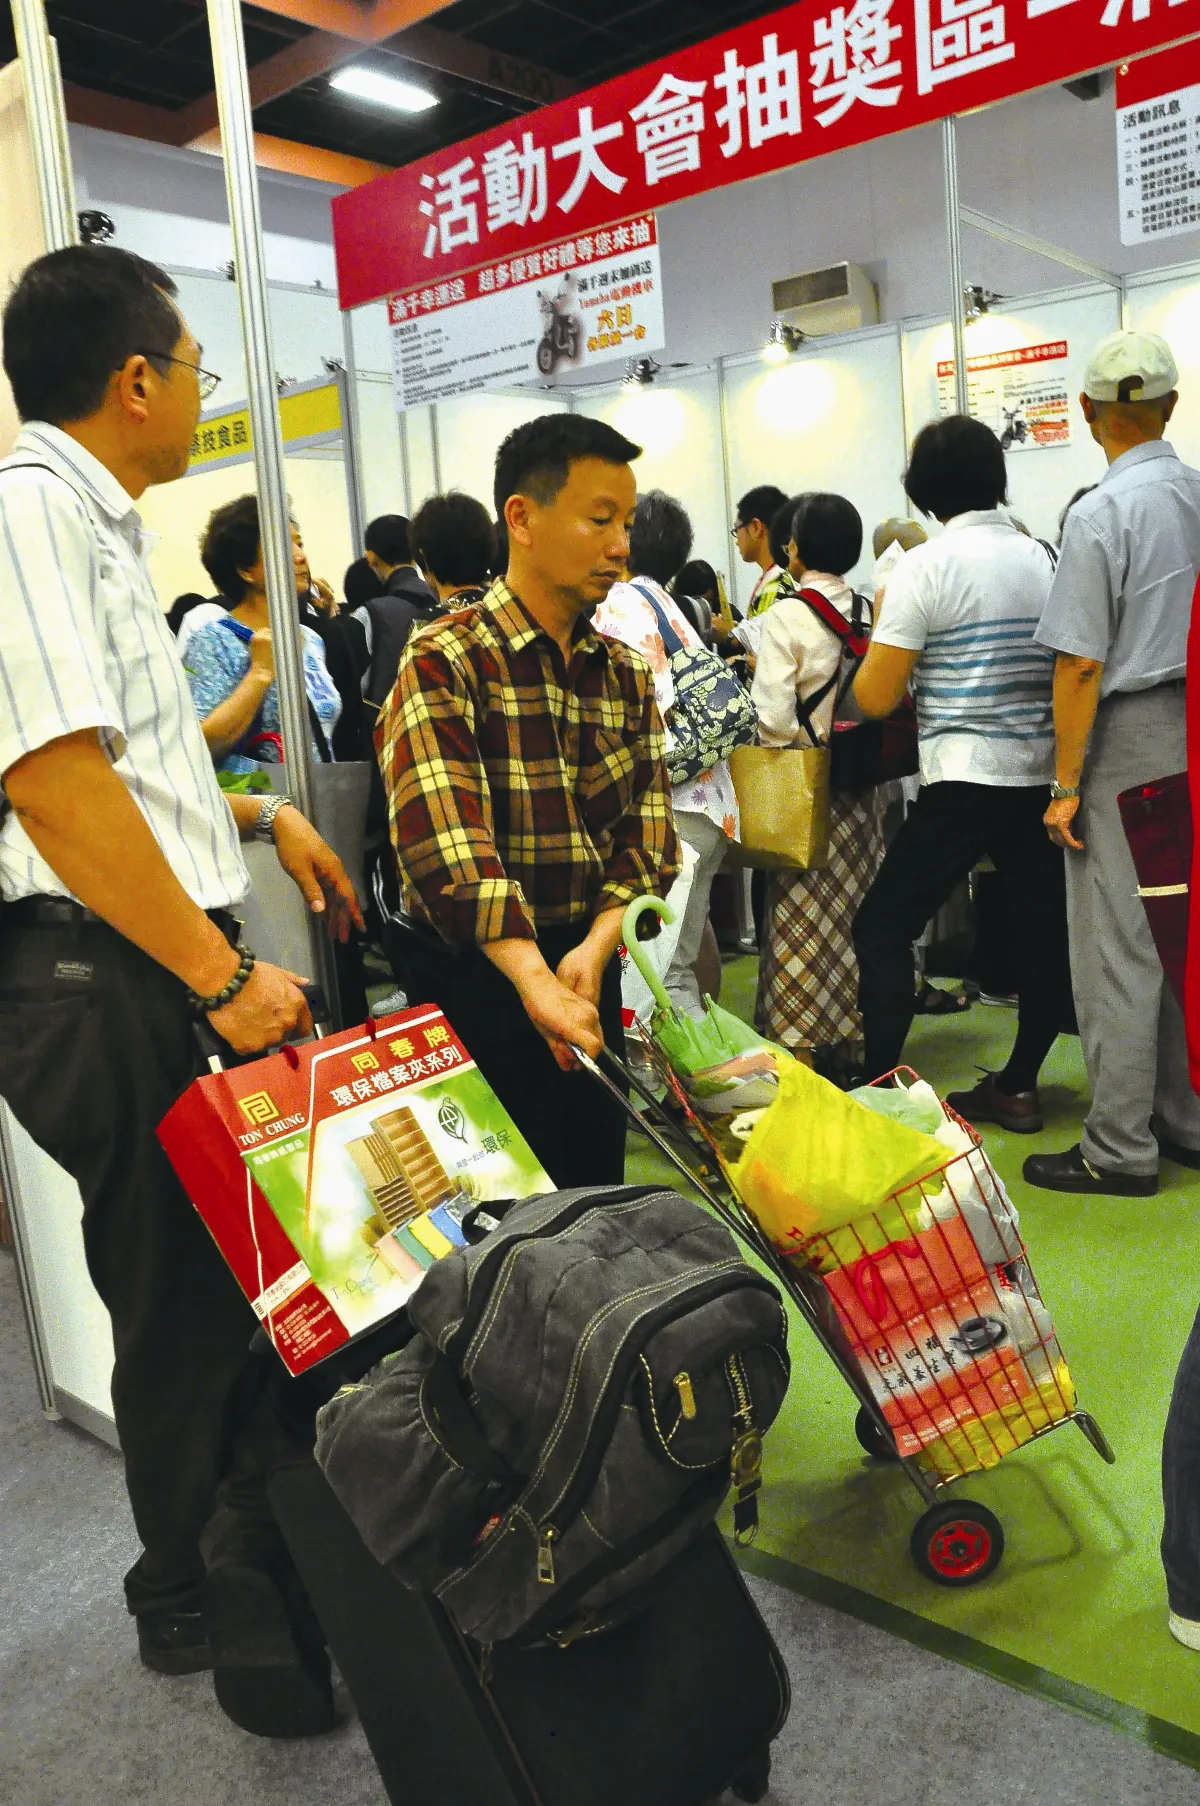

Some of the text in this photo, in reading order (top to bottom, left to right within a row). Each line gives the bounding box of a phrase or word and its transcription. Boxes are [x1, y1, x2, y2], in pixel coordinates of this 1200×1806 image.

[1123, 99, 1181, 129] 活動訊息
[351, 1025, 450, 1074] 同春牌
[329, 1044, 463, 1107] 環保檔案夾系列
[238, 1112, 305, 1146] TON CHUNG
